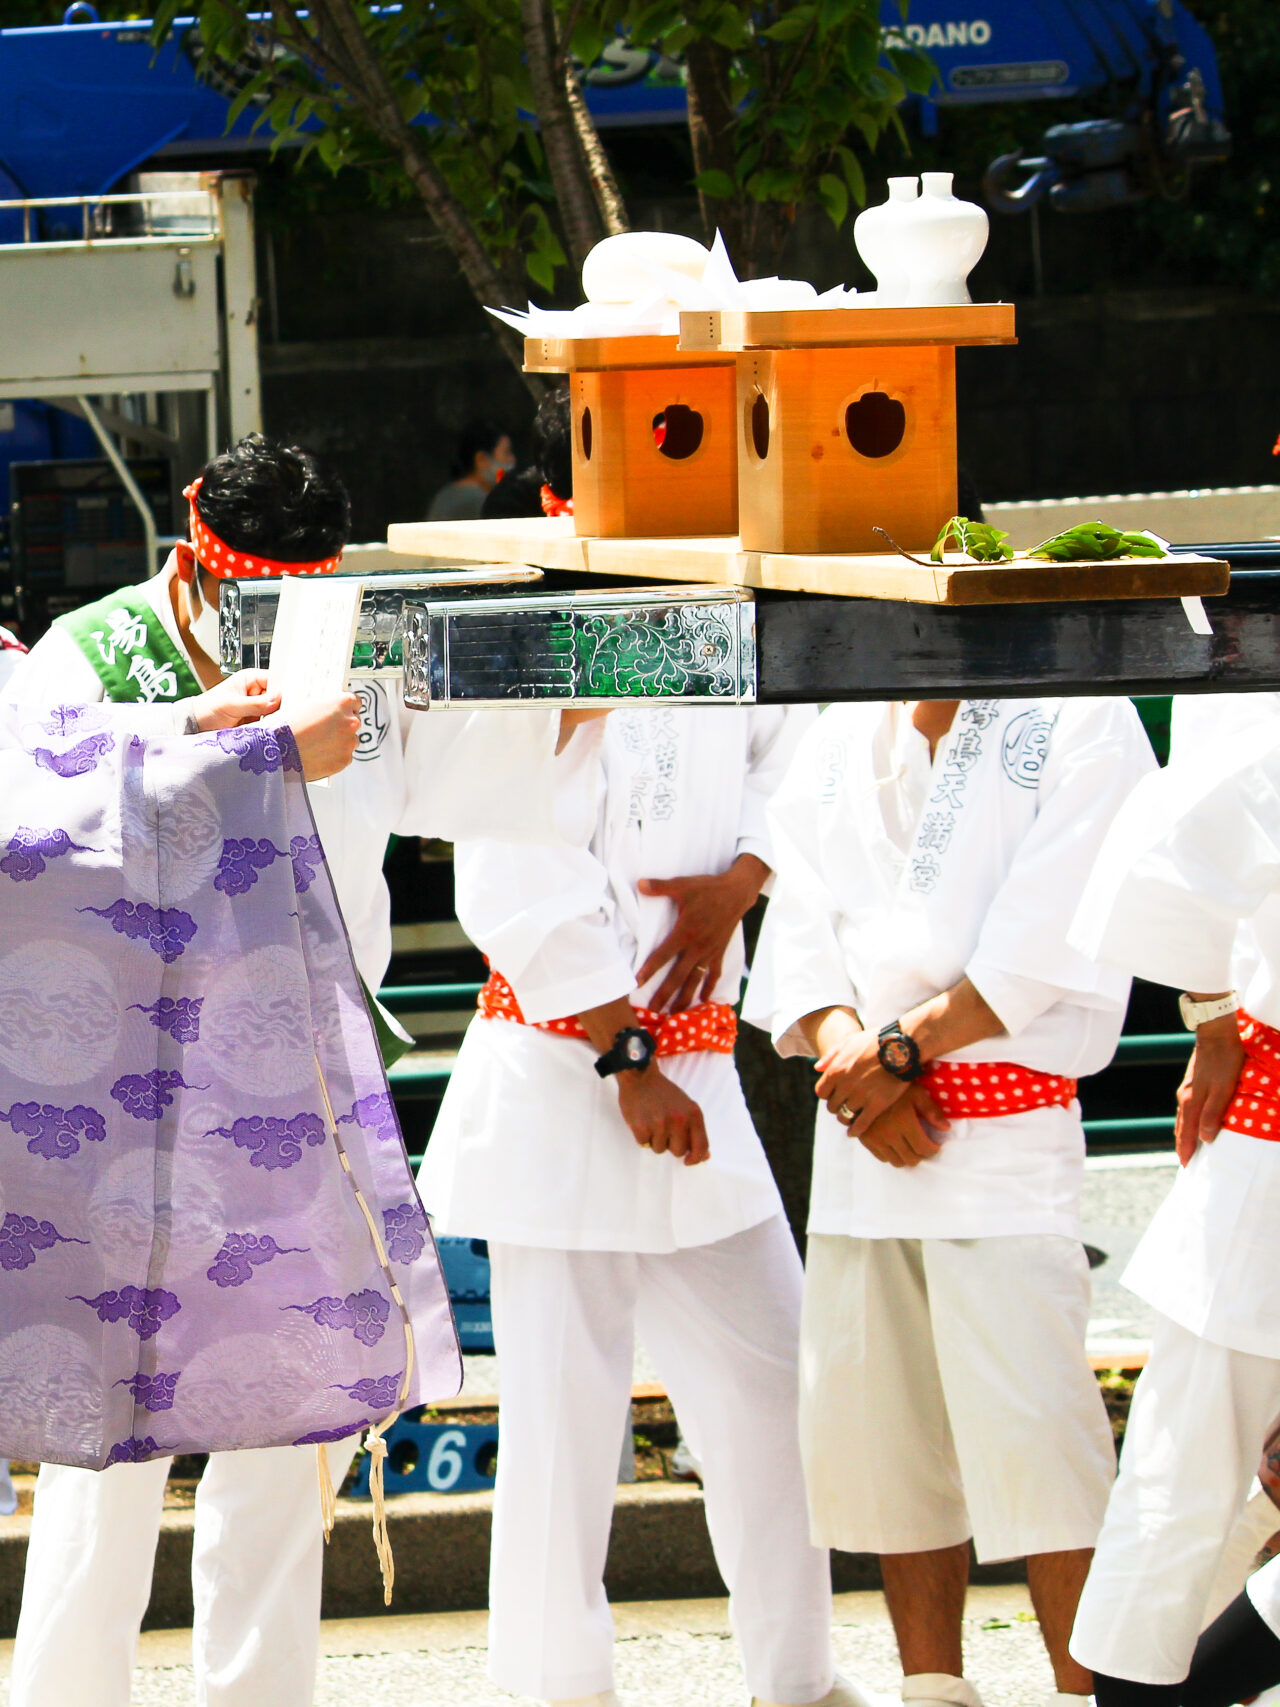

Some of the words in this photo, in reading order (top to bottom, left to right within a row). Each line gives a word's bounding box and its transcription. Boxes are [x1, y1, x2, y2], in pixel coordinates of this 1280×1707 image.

[879, 20, 991, 49] ADANO
[89, 607, 178, 703] 湯島
[427, 1430, 467, 1490] 6
